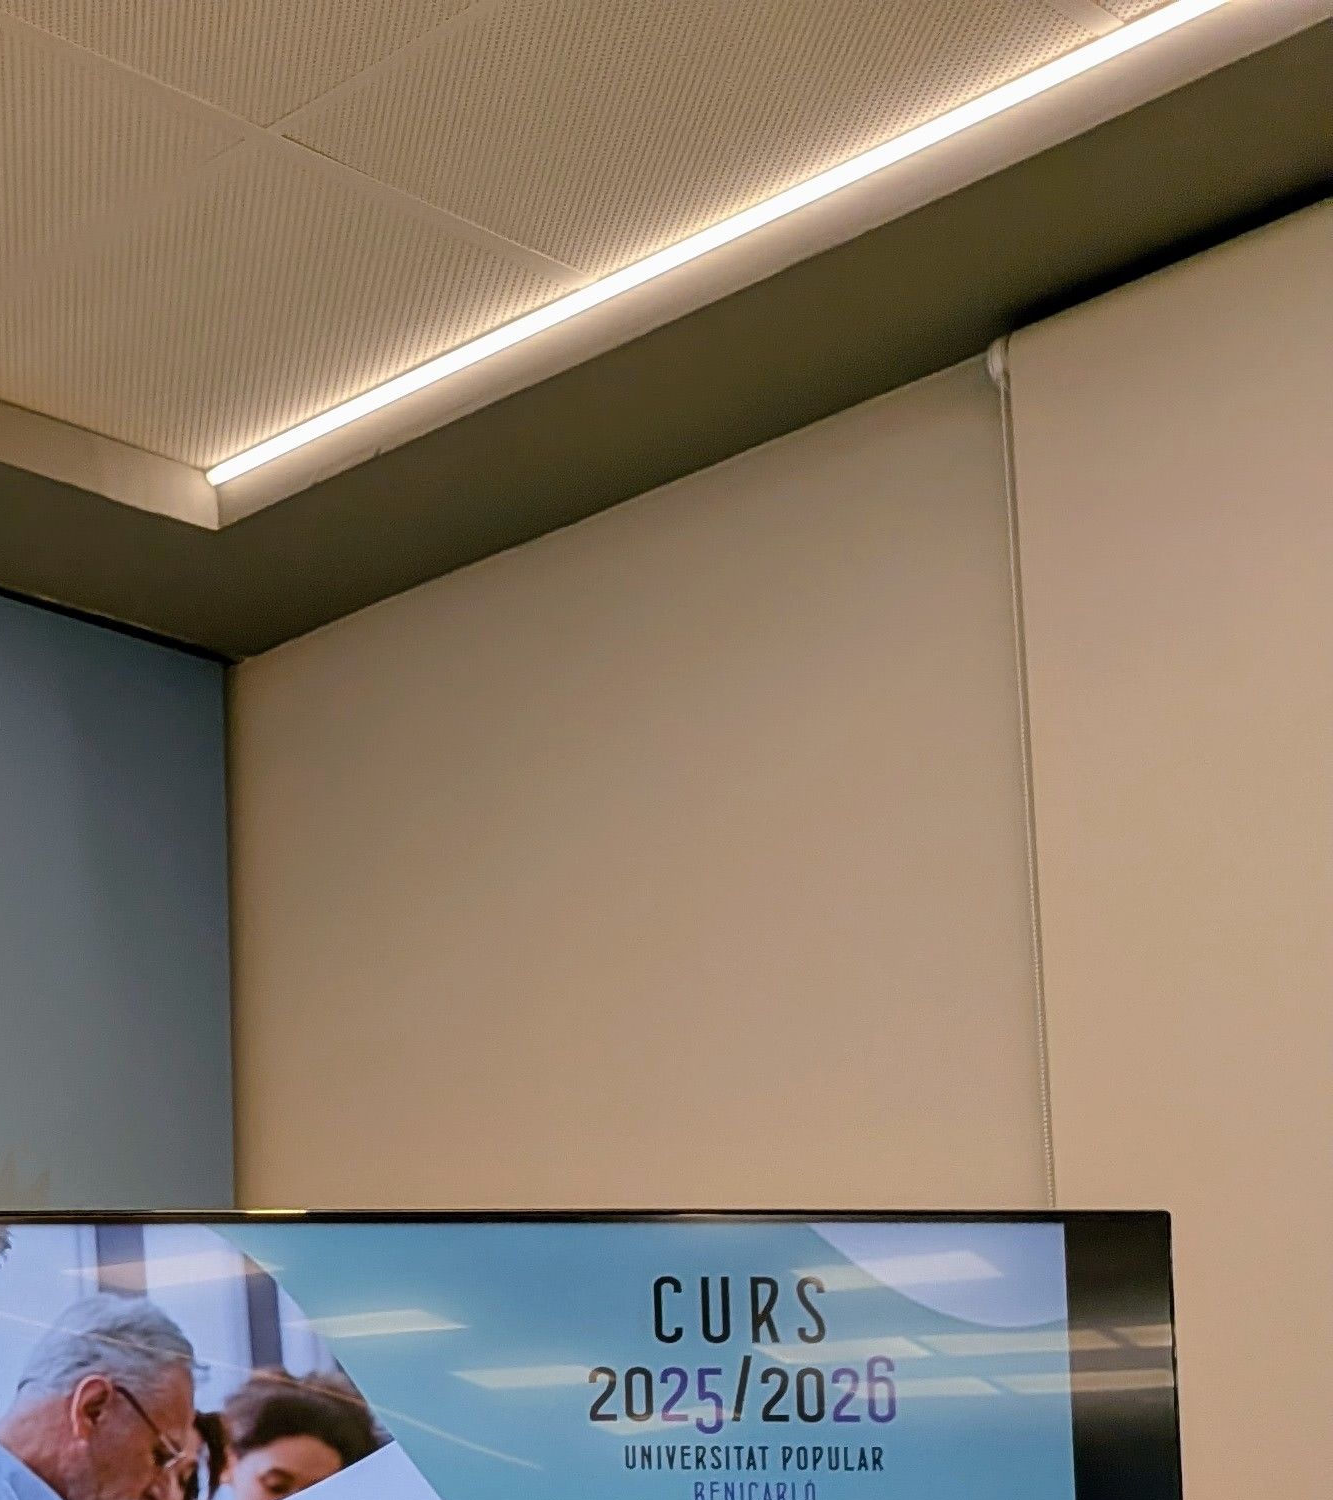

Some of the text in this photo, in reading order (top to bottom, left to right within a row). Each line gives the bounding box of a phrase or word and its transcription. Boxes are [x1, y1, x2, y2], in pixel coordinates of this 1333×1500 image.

[653, 1276, 826, 1344] CURS
[588, 1354, 897, 1435] 2025/2026
[625, 1445, 884, 1472] UNIVERSITAT POPULAR
